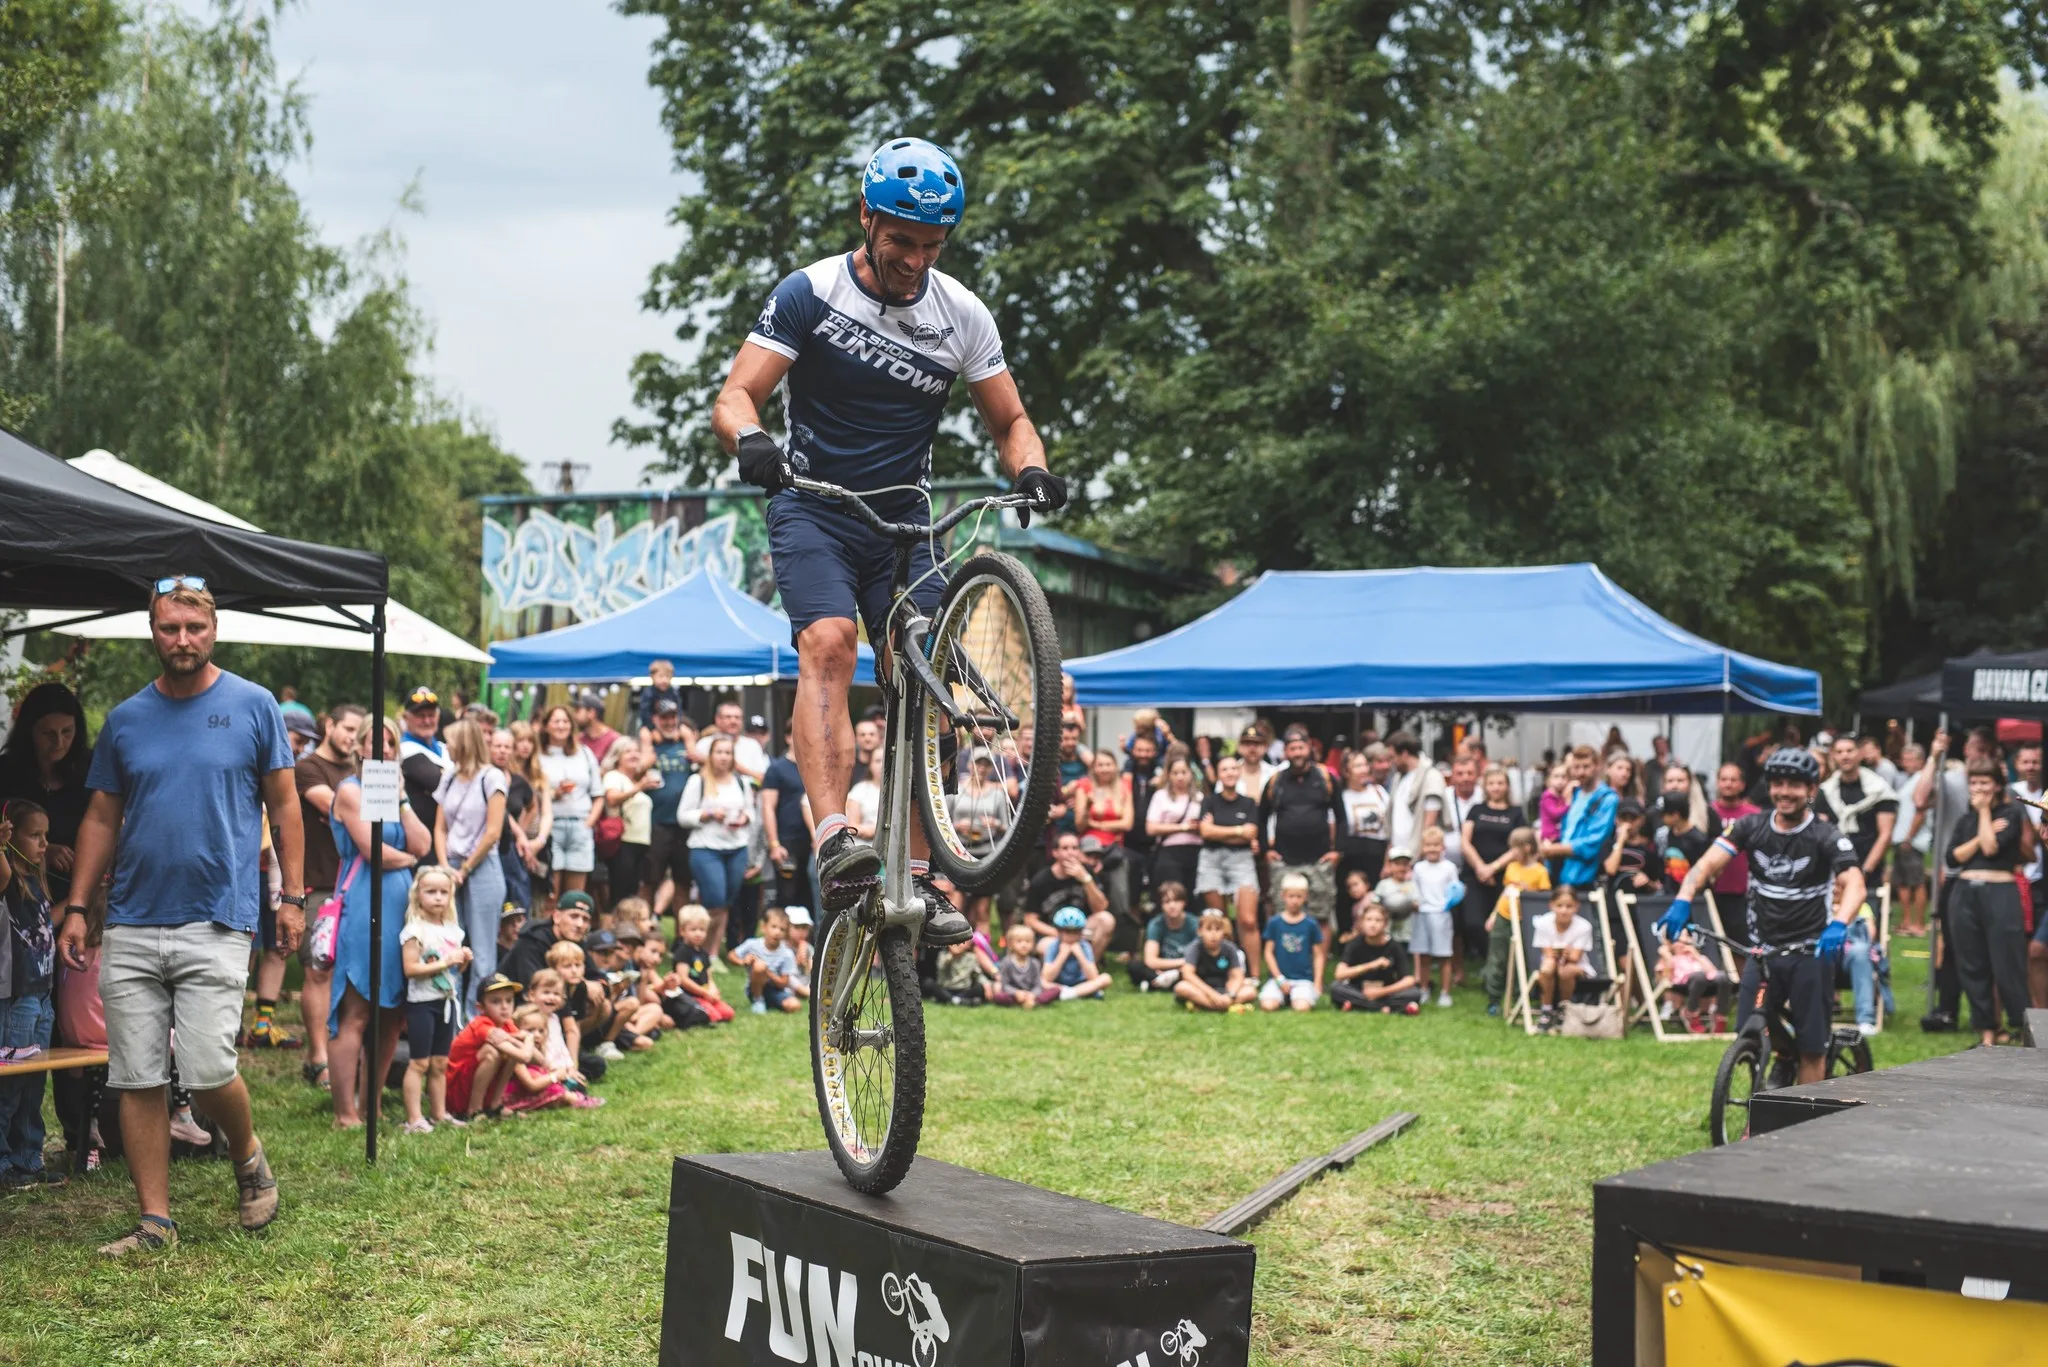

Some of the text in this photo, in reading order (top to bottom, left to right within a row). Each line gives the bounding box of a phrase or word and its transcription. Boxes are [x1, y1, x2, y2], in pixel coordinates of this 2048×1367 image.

[812, 318, 948, 395] FUNTOWN
[828, 310, 915, 361] TRIALSHOP
[1972, 669, 2031, 701] HAVANA
[207, 714, 231, 729] 94
[724, 1231, 858, 1367] FUN
